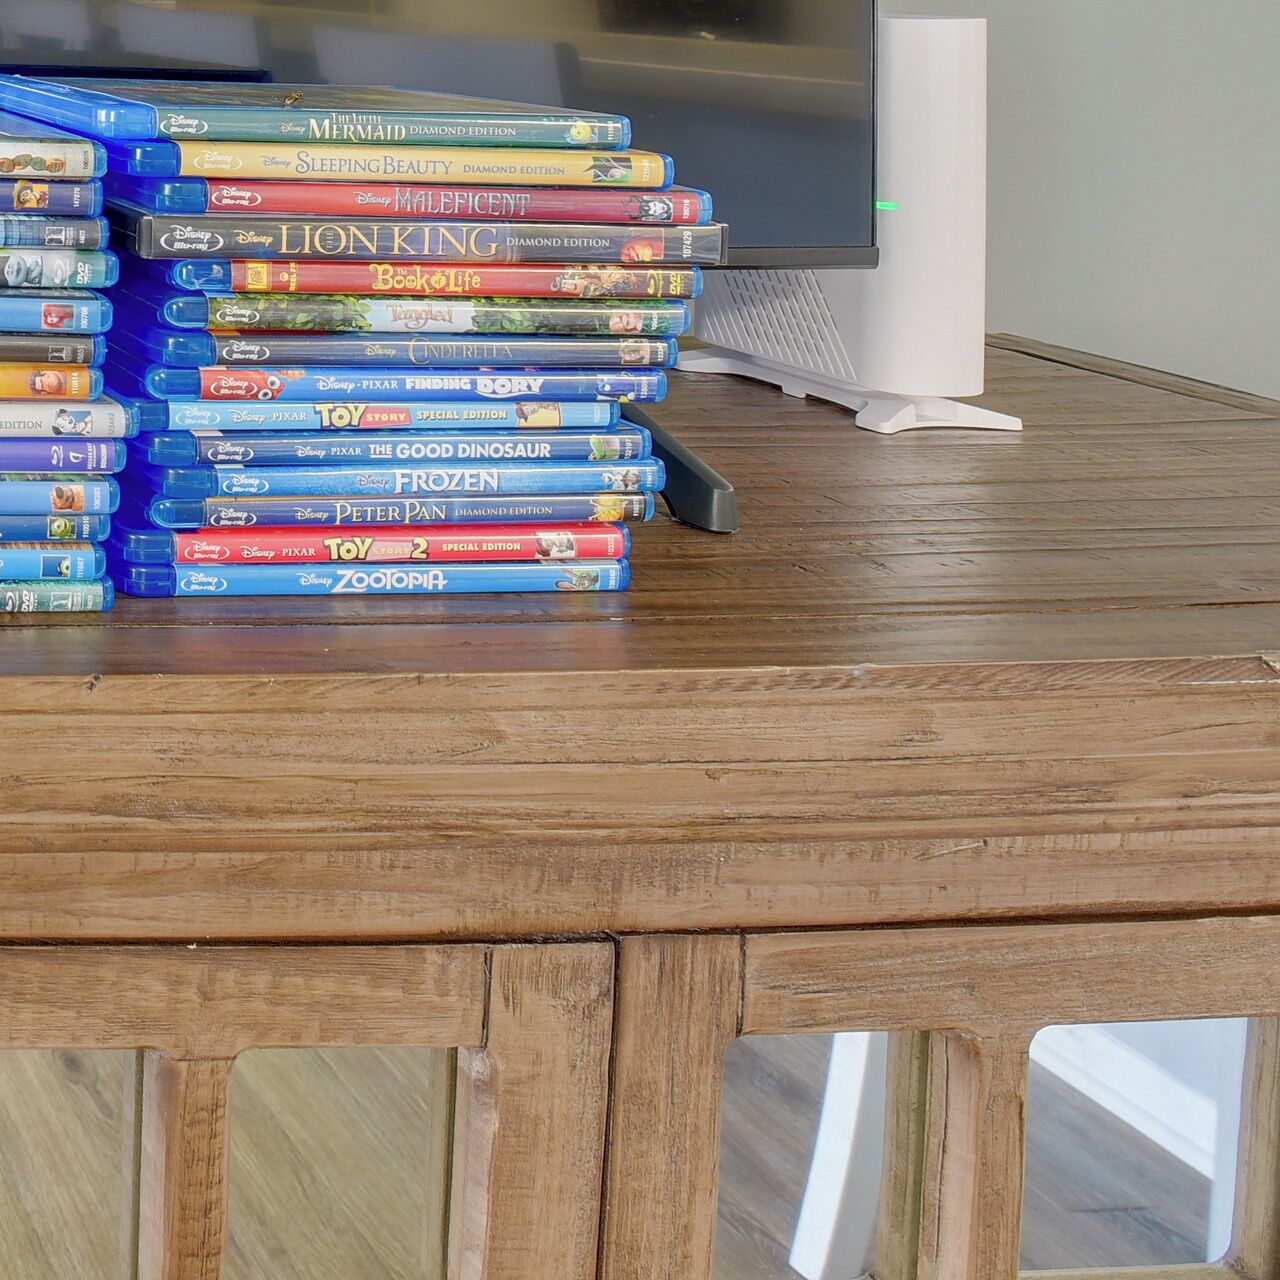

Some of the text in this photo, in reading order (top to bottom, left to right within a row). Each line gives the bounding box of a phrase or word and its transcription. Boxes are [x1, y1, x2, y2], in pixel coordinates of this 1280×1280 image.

[309, 118, 406, 143] MERMAID
[410, 126, 517, 136] DIAMOND EDITION
[295, 151, 565, 176] SLEEPING BEAUTY DIAMOND EDITION
[394, 188, 531, 217] MALEFICENT
[278, 225, 610, 258] LION KING DIAMOND EDITION
[683, 231, 692, 259] 107429
[368, 263, 434, 293] Book
[445, 269, 480, 293] Life
[386, 303, 454, 329] Tangled
[406, 336, 513, 365] CINDERELLA
[405, 378, 544, 394] FINDING DORY
[0, 420, 42, 430] EDITION
[366, 413, 407, 422] STORY
[416, 410, 459, 421] SPECIAL
[463, 410, 508, 420] EDITION
[369, 444, 551, 459] THE GOOD DINOSAUR
[394, 470, 499, 494] FROZEN
[333, 501, 553, 524] PETER PAN DIAMOND EDITION
[372, 547, 410, 555] STORY
[410, 538, 429, 560] 2
[442, 542, 479, 552] SPECIAL
[482, 542, 521, 551] EDITION
[331, 570, 447, 592] ZOOTOPIA
